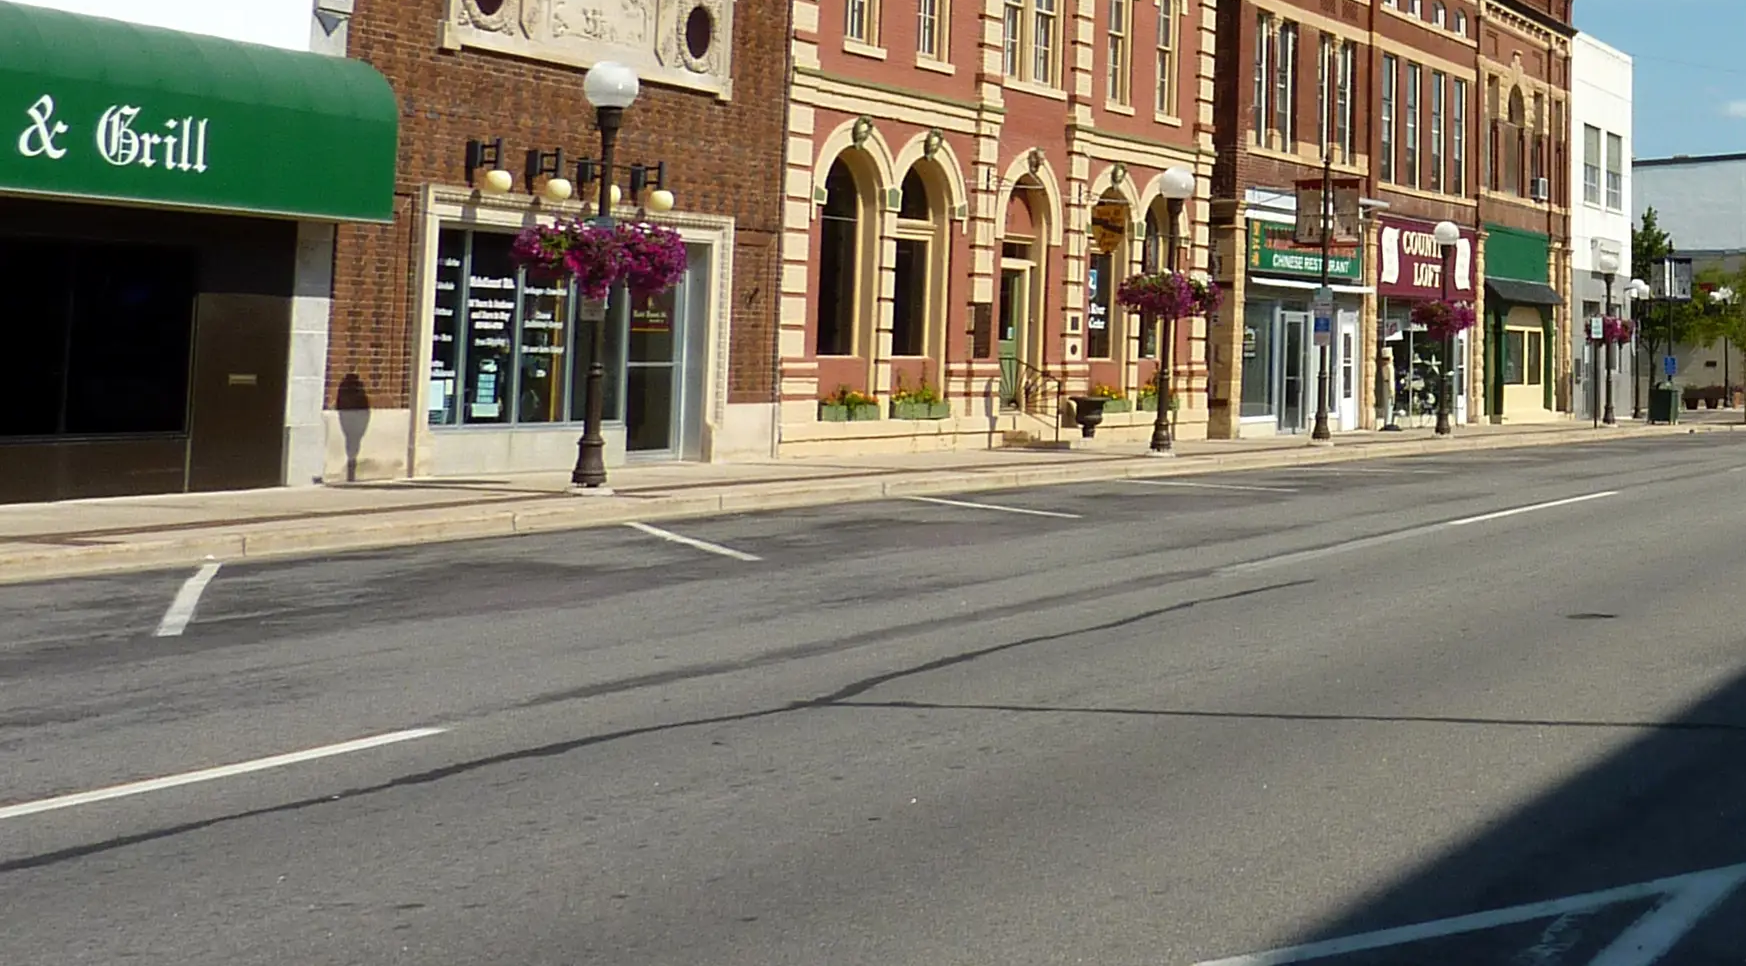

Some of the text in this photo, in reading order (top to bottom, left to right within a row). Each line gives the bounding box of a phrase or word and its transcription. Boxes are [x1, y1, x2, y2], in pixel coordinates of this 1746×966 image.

[18, 94, 209, 173] & Grill
[1272, 253, 1350, 274] CHINESE RESTRANT
[1413, 262, 1442, 288] LOFT
